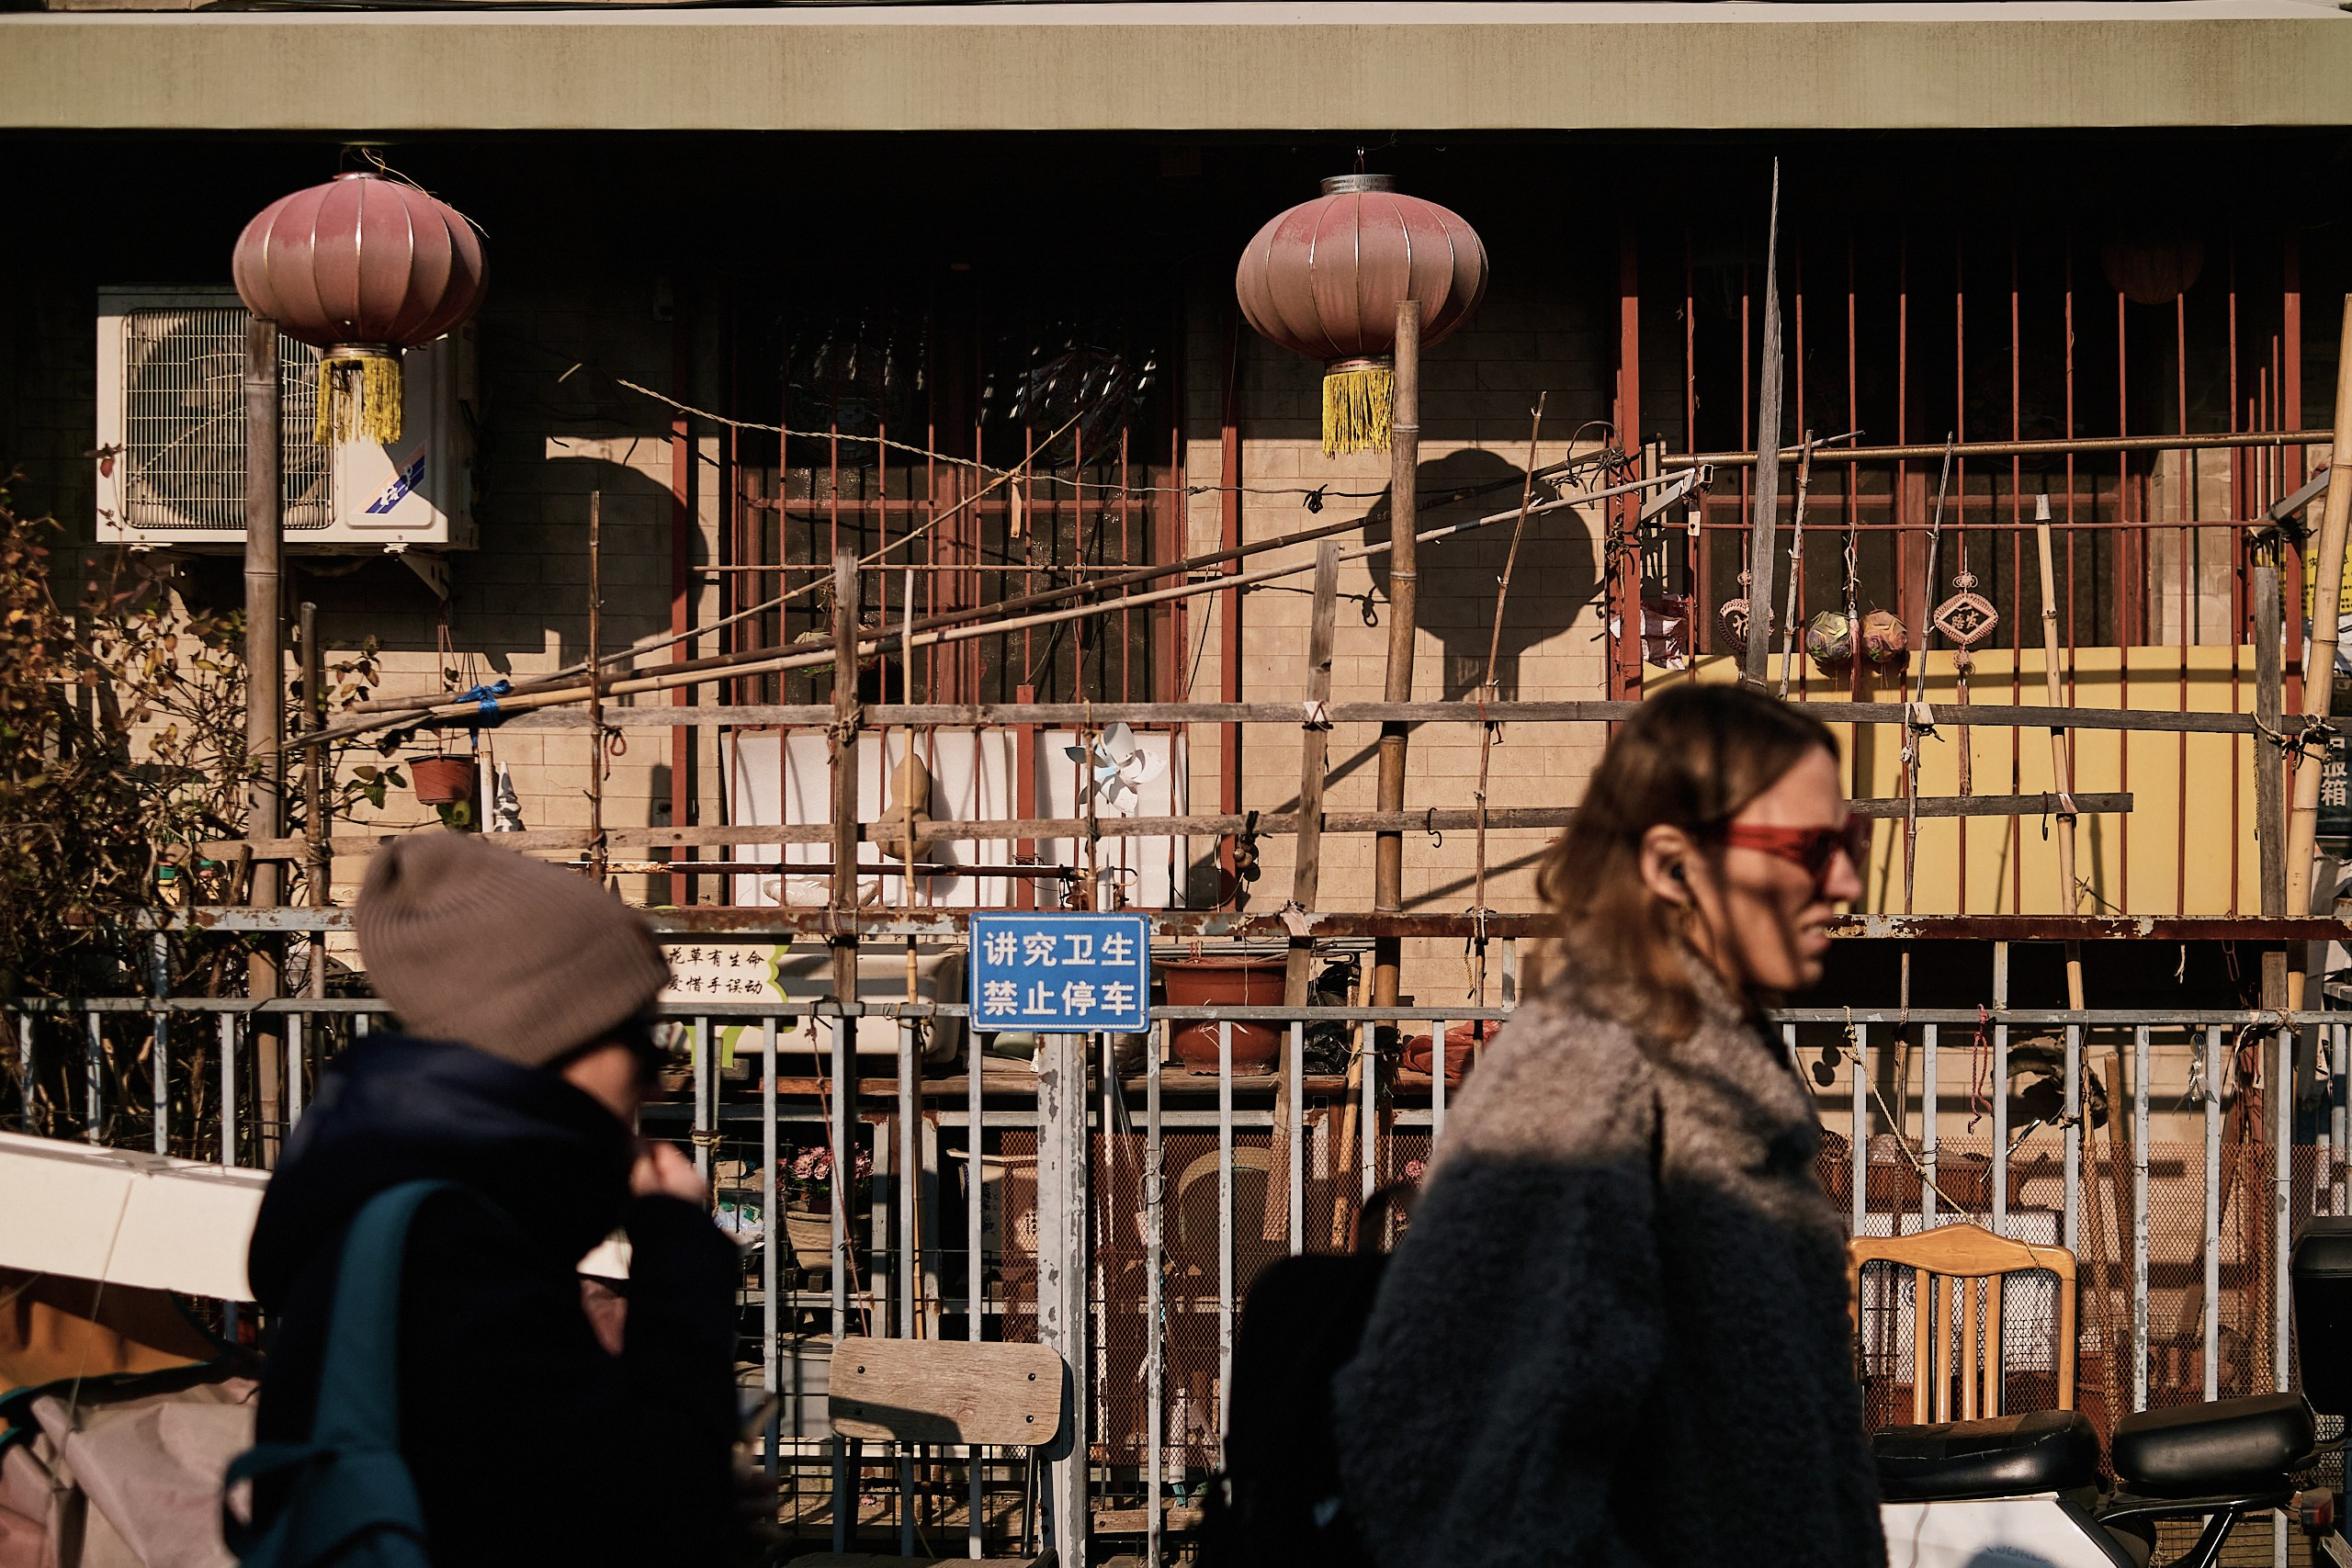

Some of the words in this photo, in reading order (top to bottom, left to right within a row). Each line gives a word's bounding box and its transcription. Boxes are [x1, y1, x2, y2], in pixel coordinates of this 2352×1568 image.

[667, 946, 765, 969] 花草有生命
[982, 931, 1136, 967] 讲究卫生
[983, 979, 1136, 1017] 禁止停车
